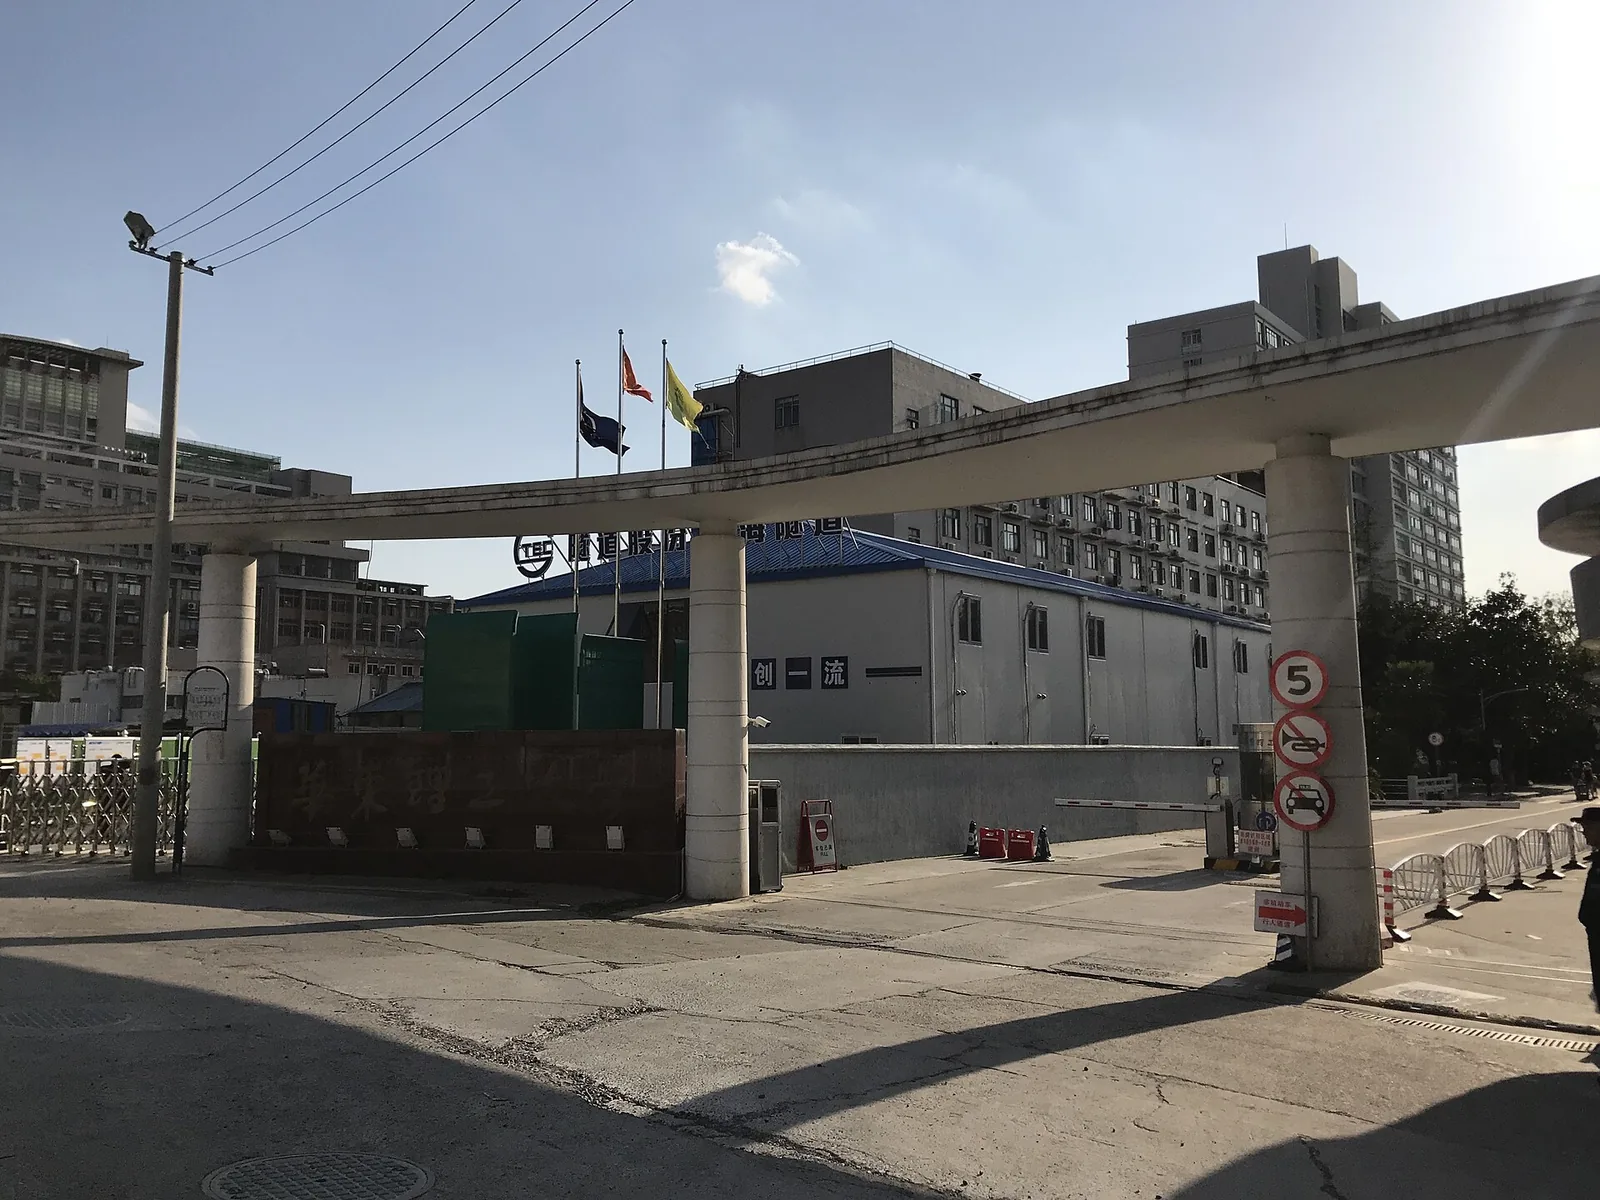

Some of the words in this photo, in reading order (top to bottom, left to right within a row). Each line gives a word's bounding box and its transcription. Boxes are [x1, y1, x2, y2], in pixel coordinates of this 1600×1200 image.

[521, 540, 553, 558] TEC
[753, 658, 846, 688] 创一流
[1287, 665, 1311, 695] 5
